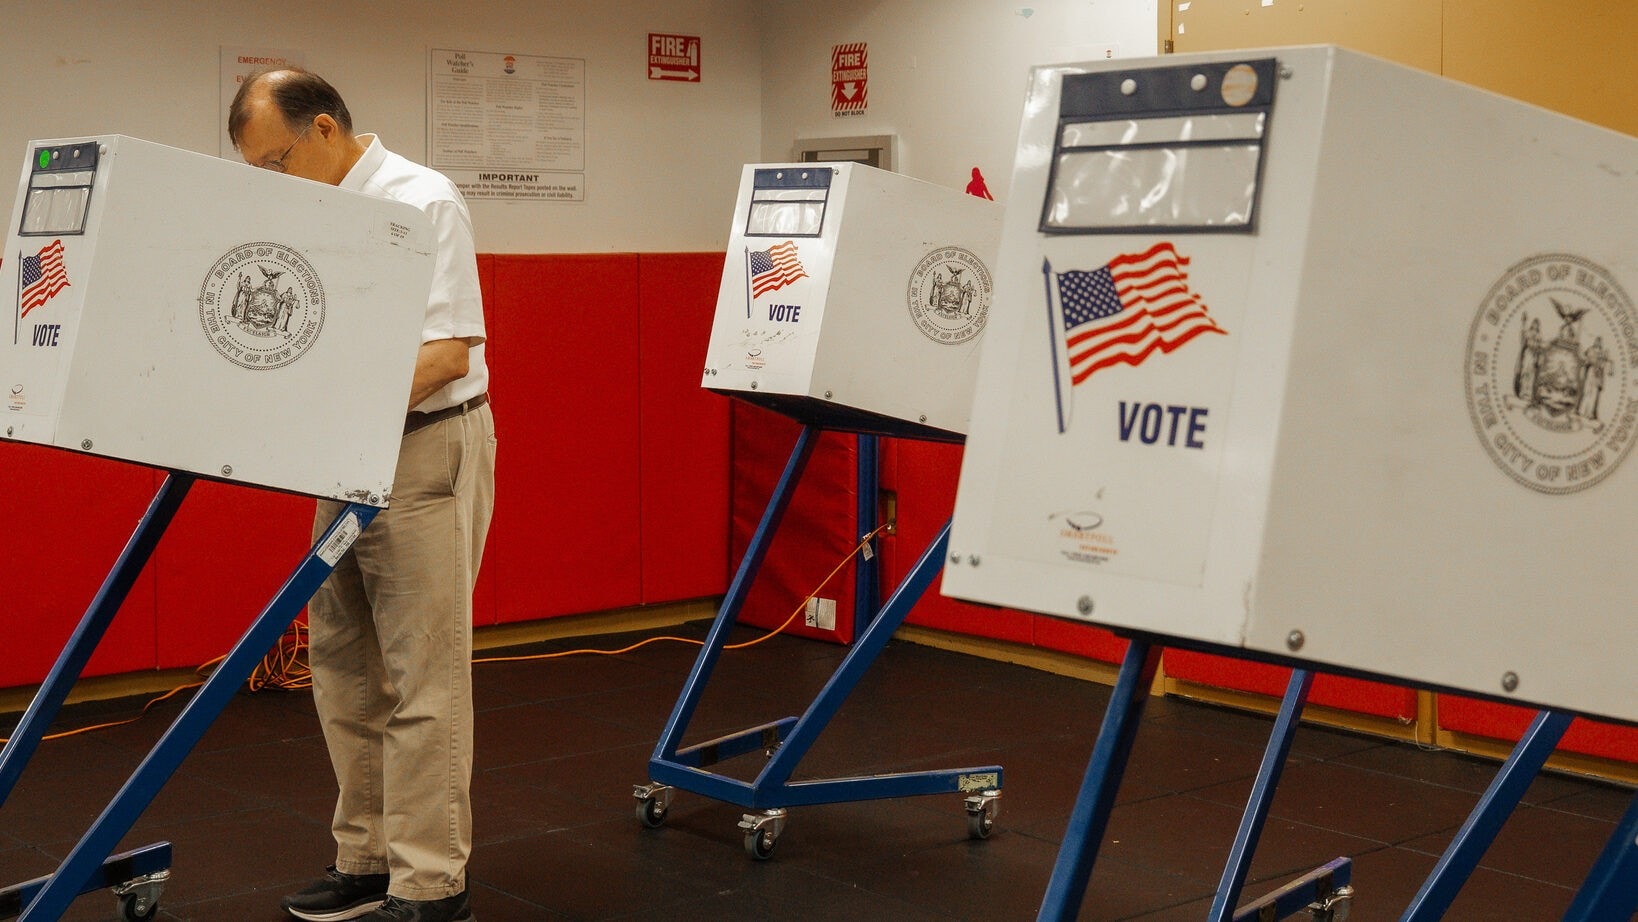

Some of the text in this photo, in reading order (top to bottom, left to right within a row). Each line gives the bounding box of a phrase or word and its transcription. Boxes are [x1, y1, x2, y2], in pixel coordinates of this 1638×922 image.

[652, 36, 684, 56] FIRE
[237, 56, 287, 65] EMERGENCY
[446, 59, 474, 67] Watcher's
[650, 55, 690, 65] EXTINGUISHER
[839, 53, 861, 67] FIRE
[451, 66, 469, 74] Guide
[833, 69, 866, 82] EXTINGUISHER
[479, 173, 540, 182] IMPORTANT
[214, 248, 320, 306] BOARD OF ELECTIONS
[917, 253, 943, 277] BOARD
[958, 253, 990, 294] ELECTIONS
[911, 287, 918, 298] IN
[1485, 269, 1542, 326] BOARD
[1545, 264, 1571, 281] OF
[769, 304, 801, 323] VOTE
[912, 300, 923, 319] THE
[32, 324, 61, 347] VOTE
[205, 291, 317, 363] IN THE CITY OF NEW YORK
[920, 319, 940, 336] CITY
[940, 332, 952, 340] OF
[954, 326, 973, 339] NEW
[1473, 351, 1488, 376] IN
[1474, 382, 1499, 429] THE
[1118, 400, 1209, 450] VOTE
[1494, 432, 1535, 473] CITY
[1535, 464, 1561, 482] OF
[1566, 451, 1606, 481] NEW
